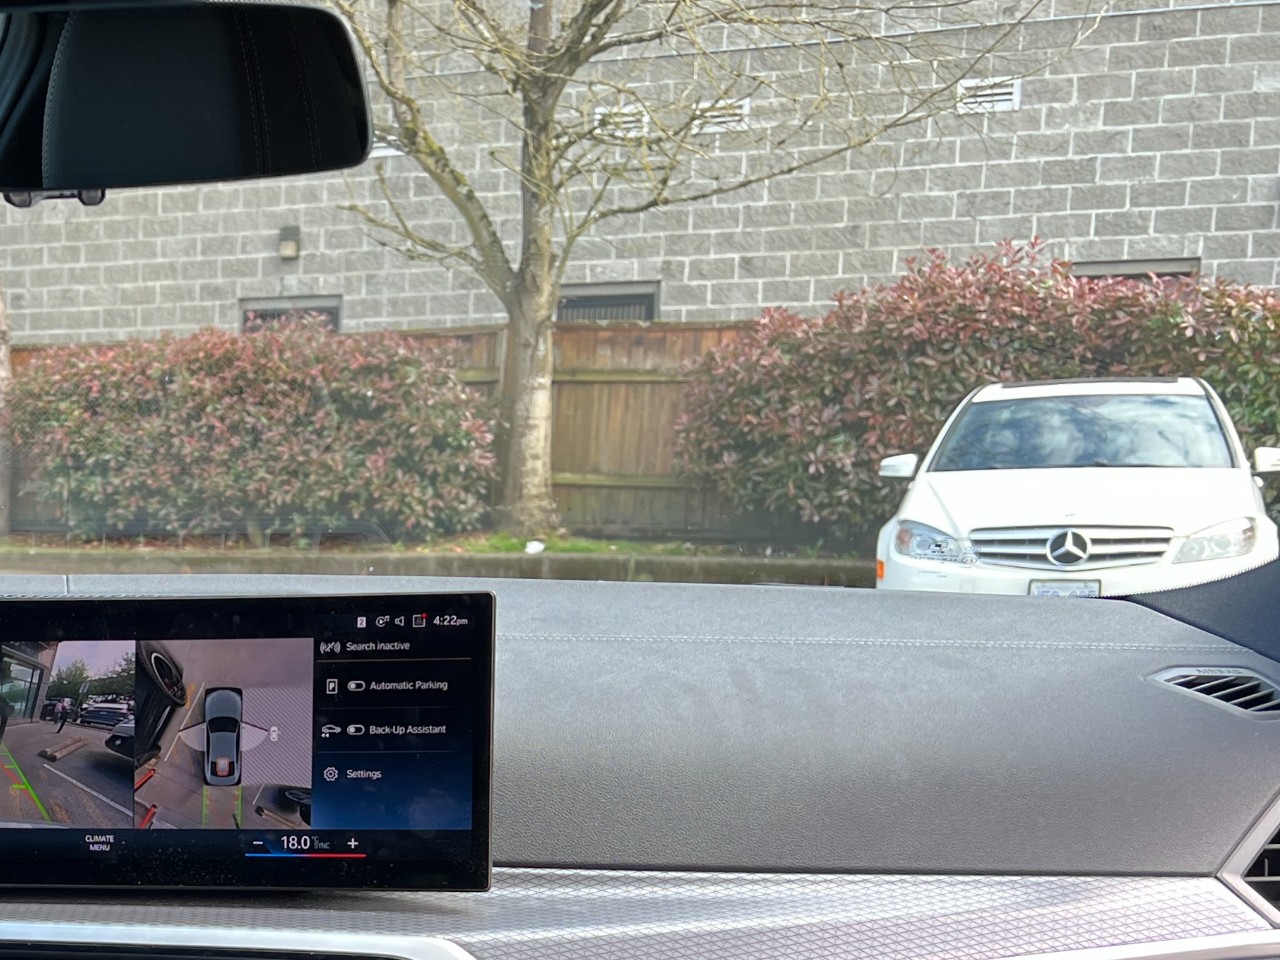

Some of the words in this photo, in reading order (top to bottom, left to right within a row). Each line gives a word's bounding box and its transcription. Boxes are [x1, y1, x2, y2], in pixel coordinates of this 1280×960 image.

[433, 615, 469, 626] 4:22pm
[346, 642, 375, 651] Search
[376, 641, 410, 651] inactive
[369, 681, 414, 691] Automatic
[415, 680, 448, 691] Parking
[369, 725, 405, 736] Back-Up
[406, 724, 447, 734] Assistant
[346, 769, 382, 780] Settings
[84, 834, 115, 843] CLIMATE
[280, 835, 310, 850] 18.0
[89, 843, 111, 851] MENU
